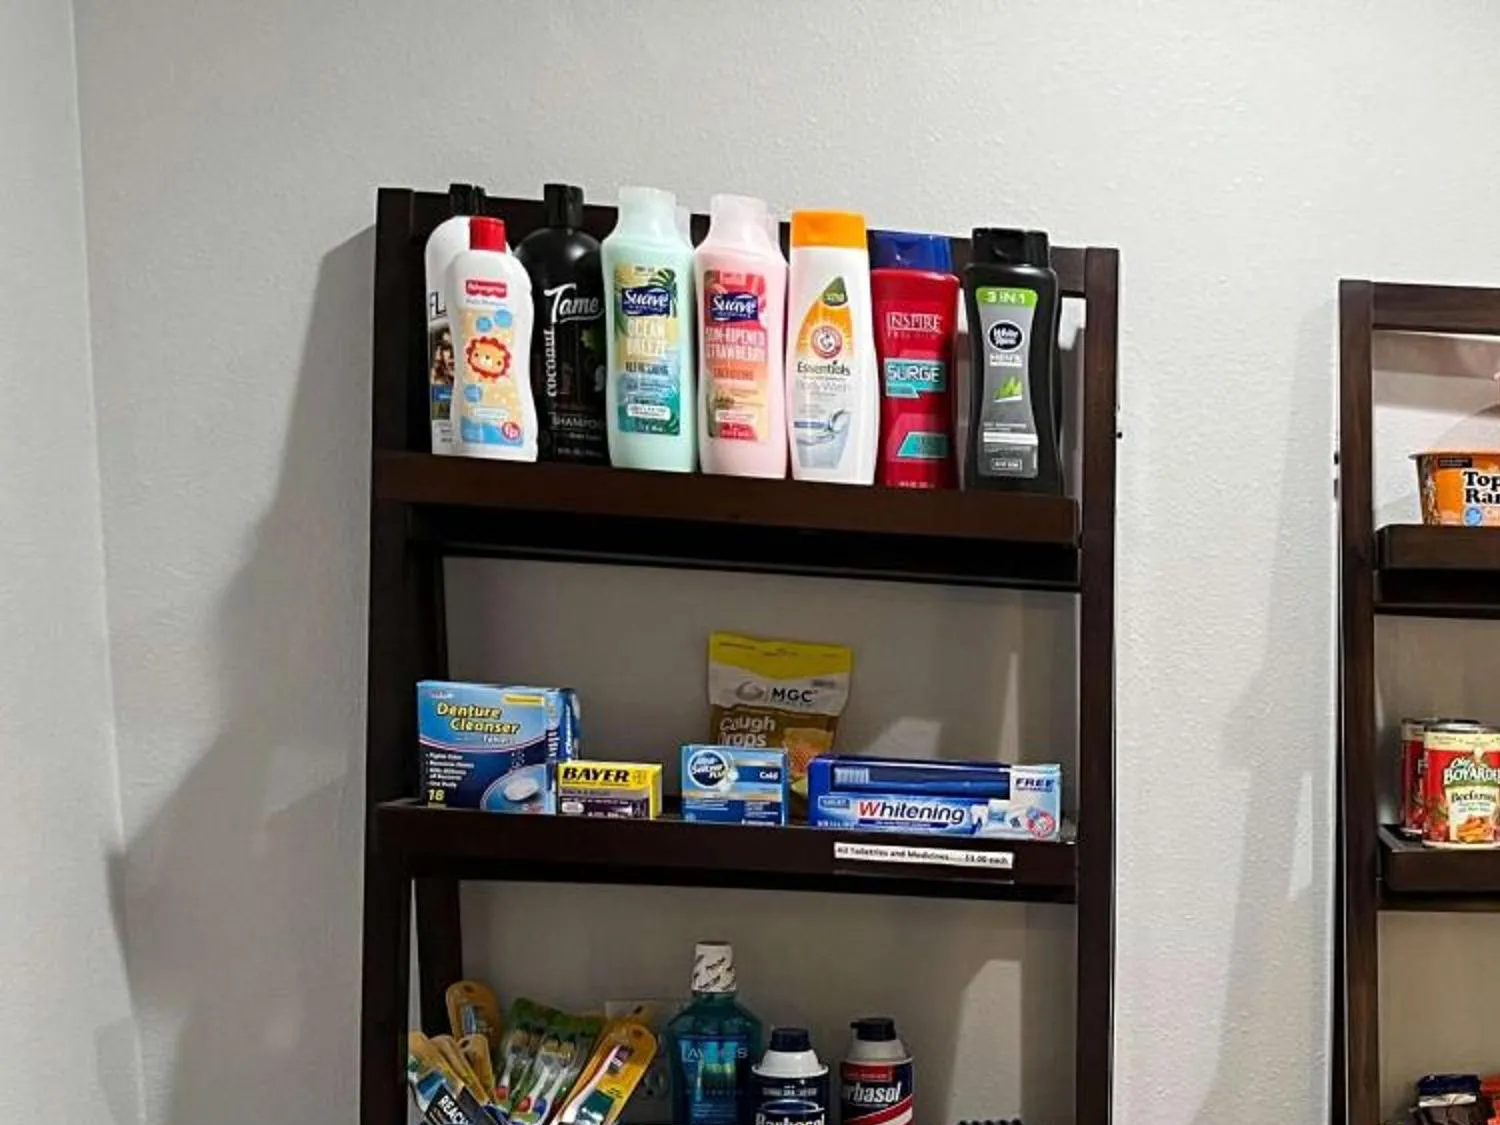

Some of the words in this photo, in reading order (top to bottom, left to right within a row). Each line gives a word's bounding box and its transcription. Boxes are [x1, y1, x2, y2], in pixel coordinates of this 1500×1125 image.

[544, 283, 599, 324] Tame
[624, 289, 669, 308] Suave
[712, 296, 756, 314] Suave
[887, 365, 940, 382] SURGE
[772, 687, 813, 703] MGC
[437, 702, 502, 719] Denture
[450, 717, 521, 735] Cleanser
[719, 716, 775, 732] Cough
[562, 767, 630, 783] BAYER
[859, 800, 964, 825] Whitening
